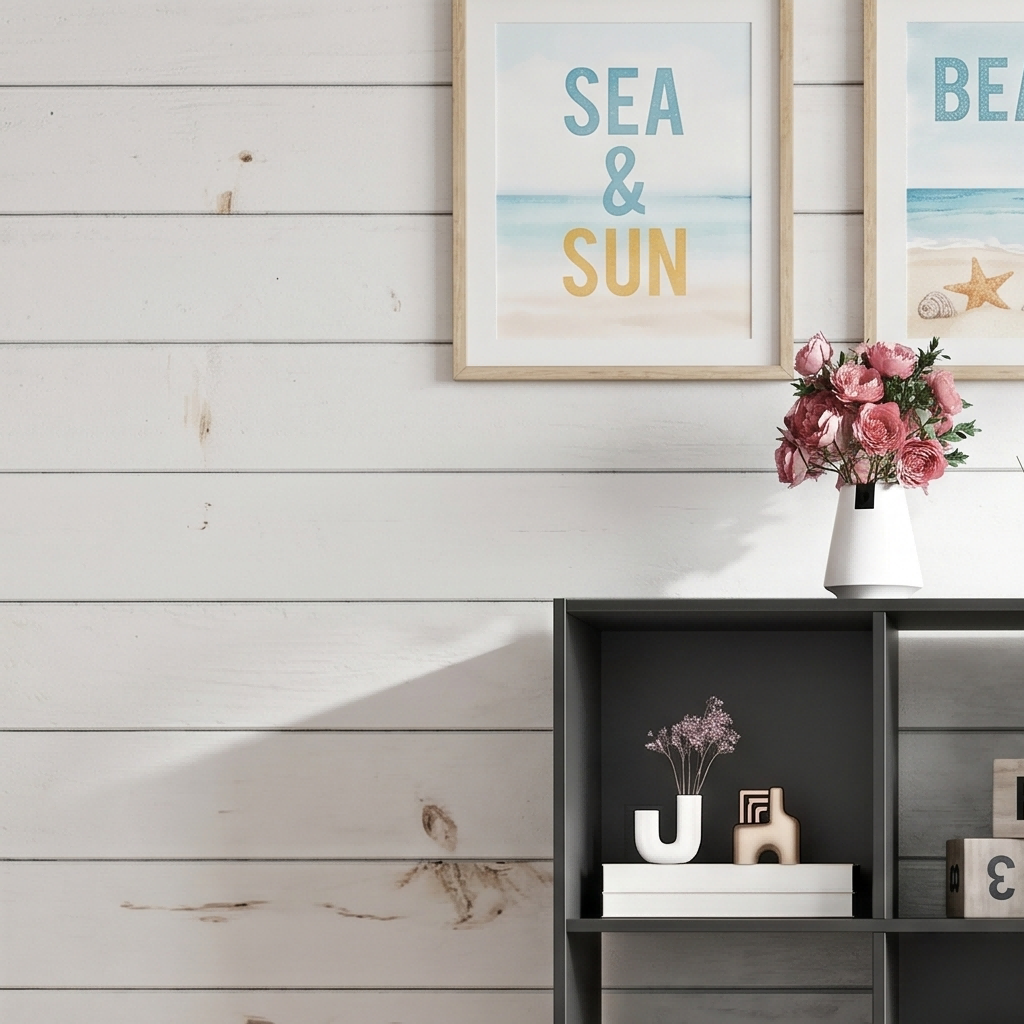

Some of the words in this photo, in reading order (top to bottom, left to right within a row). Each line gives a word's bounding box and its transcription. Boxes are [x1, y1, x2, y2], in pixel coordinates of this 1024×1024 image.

[564, 66, 684, 136] SEA
[602, 146, 646, 216] &
[562, 227, 687, 297] SUN
